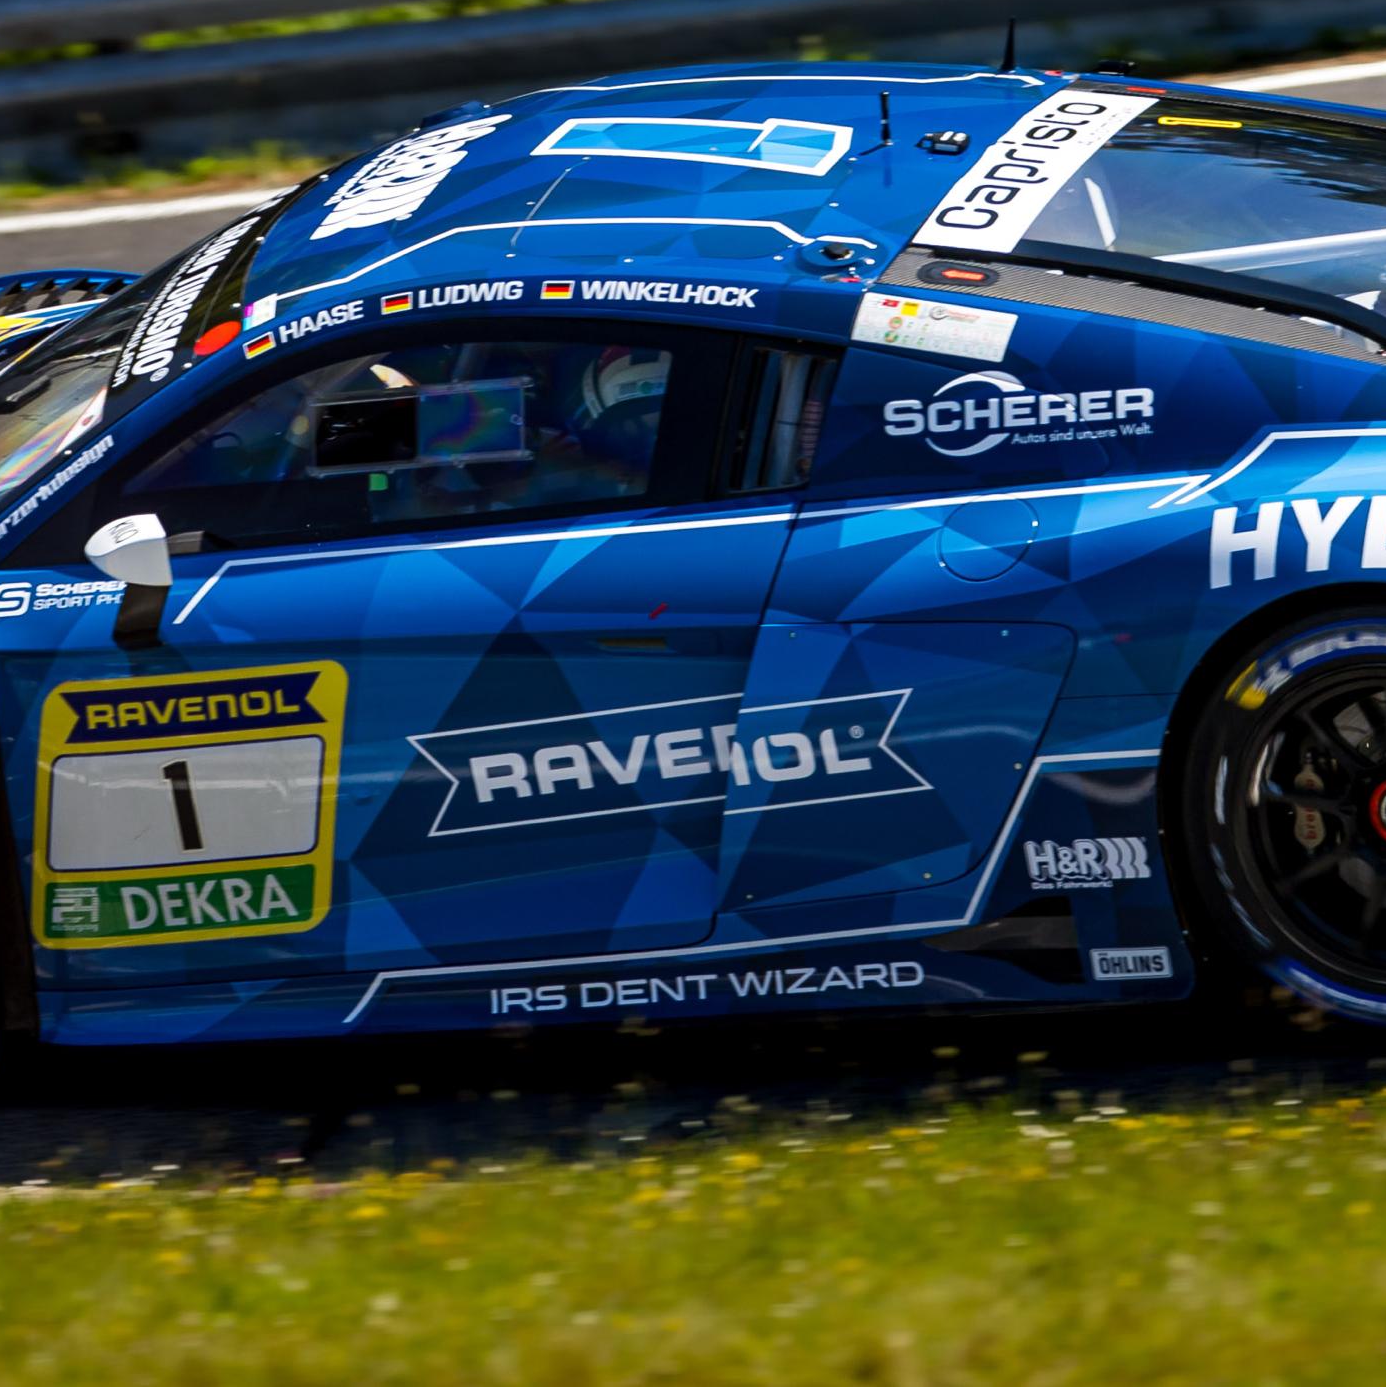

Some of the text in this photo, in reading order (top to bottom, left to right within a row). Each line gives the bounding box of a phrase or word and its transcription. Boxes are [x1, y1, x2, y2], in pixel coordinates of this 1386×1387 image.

[935, 102, 1107, 229] Capristo
[187, 216, 261, 274] GRAN
[418, 281, 523, 309] LUDWIG
[580, 281, 757, 308] WINKELHOCK
[279, 300, 363, 343] HAASE
[883, 388, 1154, 436] SCHERER
[1011, 433, 1046, 445] Autos
[1049, 429, 1073, 442] sind
[33, 595, 94, 610] SPORT
[86, 689, 300, 730] RAVENOL
[162, 759, 204, 852] 1
[1024, 837, 1113, 881] H&R
[120, 874, 299, 929] DEKRA
[1098, 952, 1165, 974] ÖHLINS
[490, 962, 924, 1014] IRS DENT WIZARD
